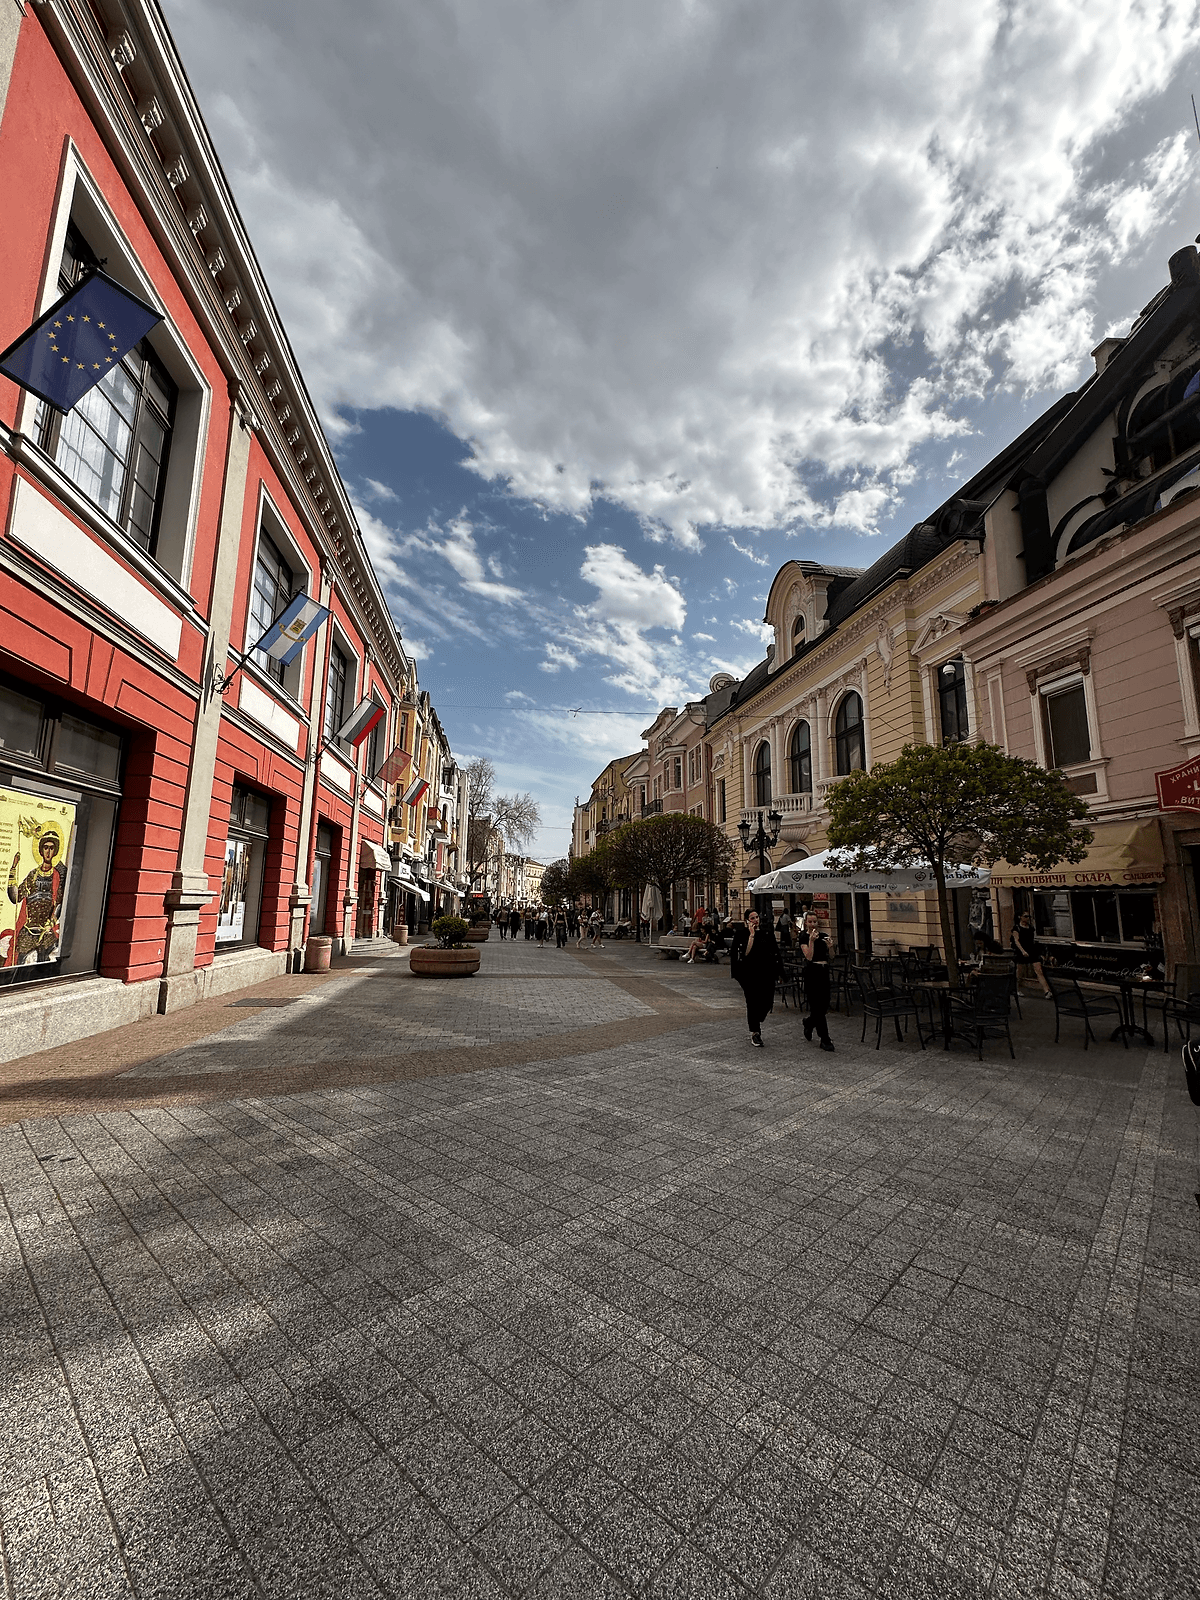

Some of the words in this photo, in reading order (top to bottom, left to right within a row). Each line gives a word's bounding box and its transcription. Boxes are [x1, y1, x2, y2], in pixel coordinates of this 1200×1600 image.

[1169, 765, 1200, 784] ХРАНИ
[1013, 874, 1066, 885] САНДВИЧИ
[1074, 872, 1112, 883] СКАРА
